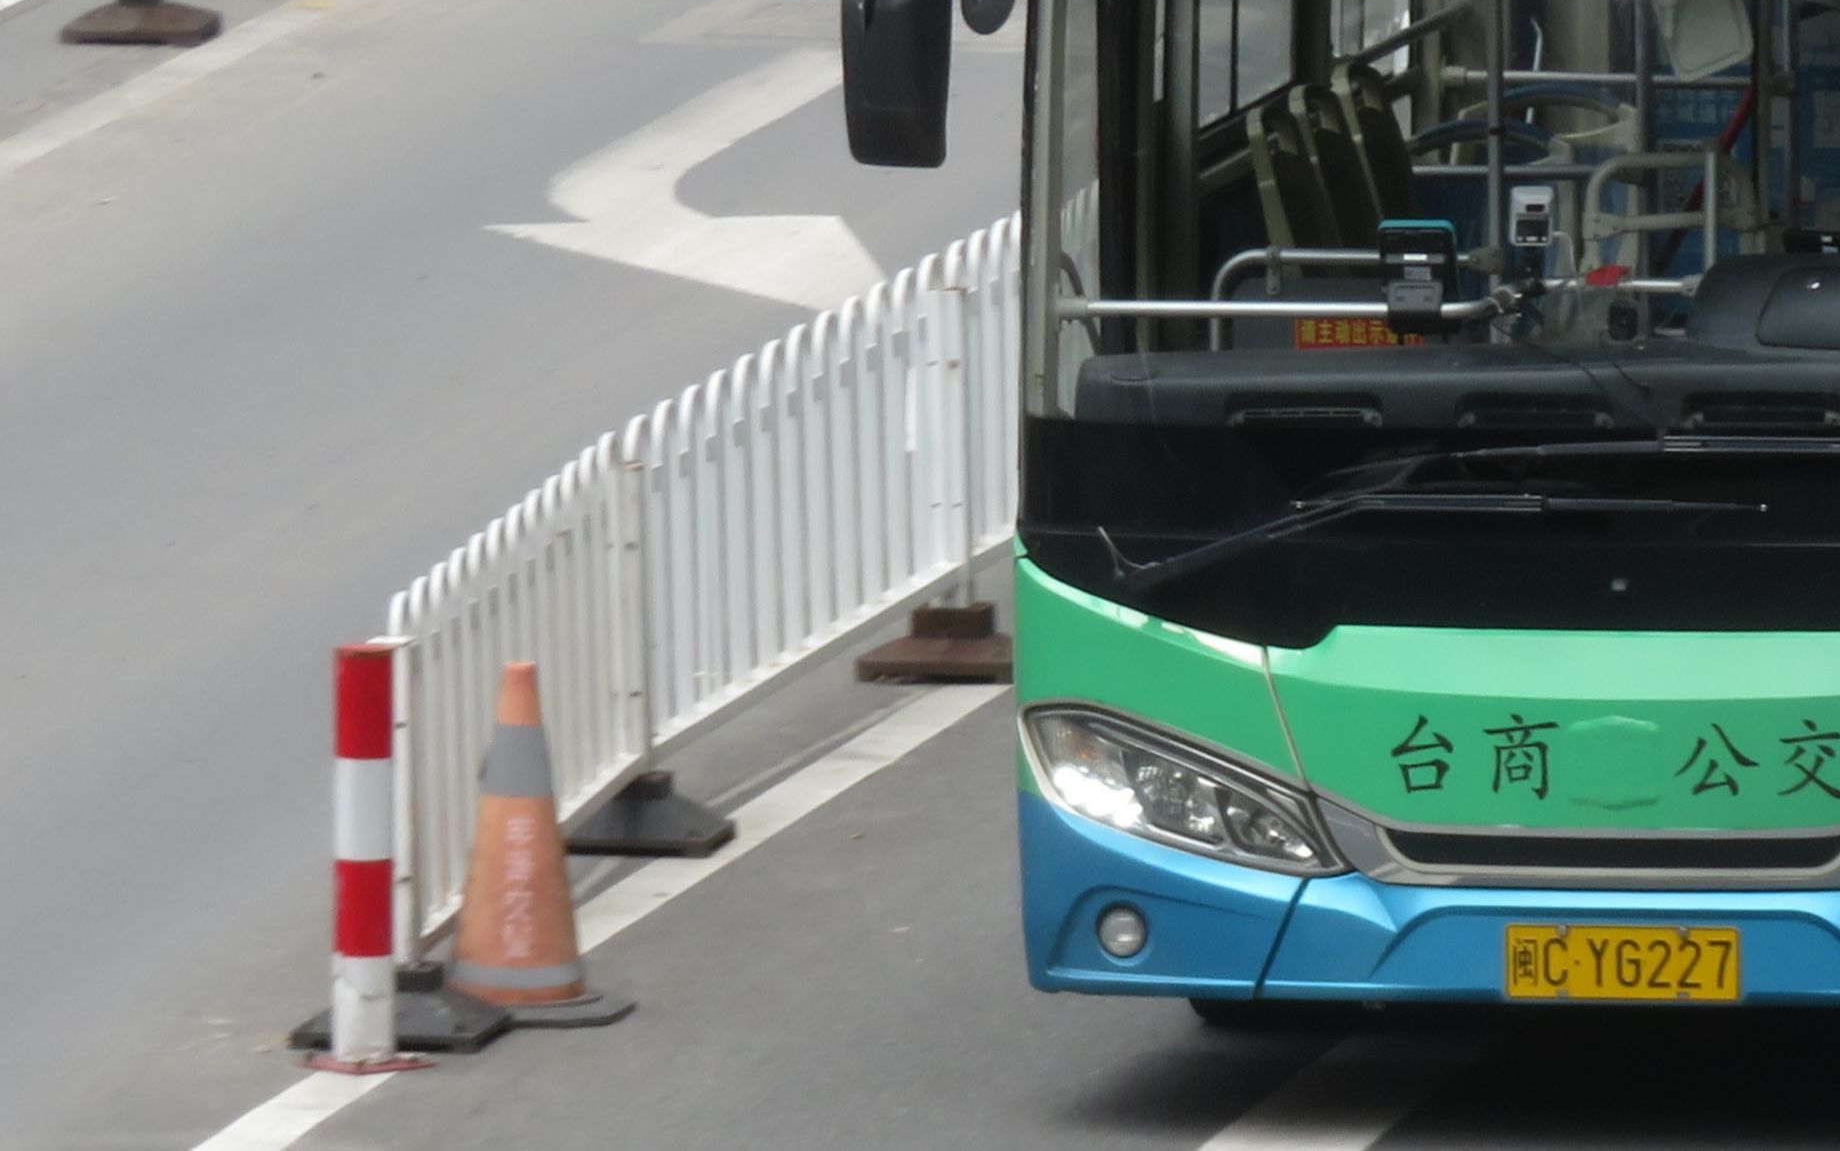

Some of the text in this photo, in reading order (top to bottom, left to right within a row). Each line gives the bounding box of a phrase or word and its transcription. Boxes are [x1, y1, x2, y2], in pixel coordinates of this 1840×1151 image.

[1301, 318, 1424, 345] 请主动出示
[1391, 714, 1558, 800] 台商
